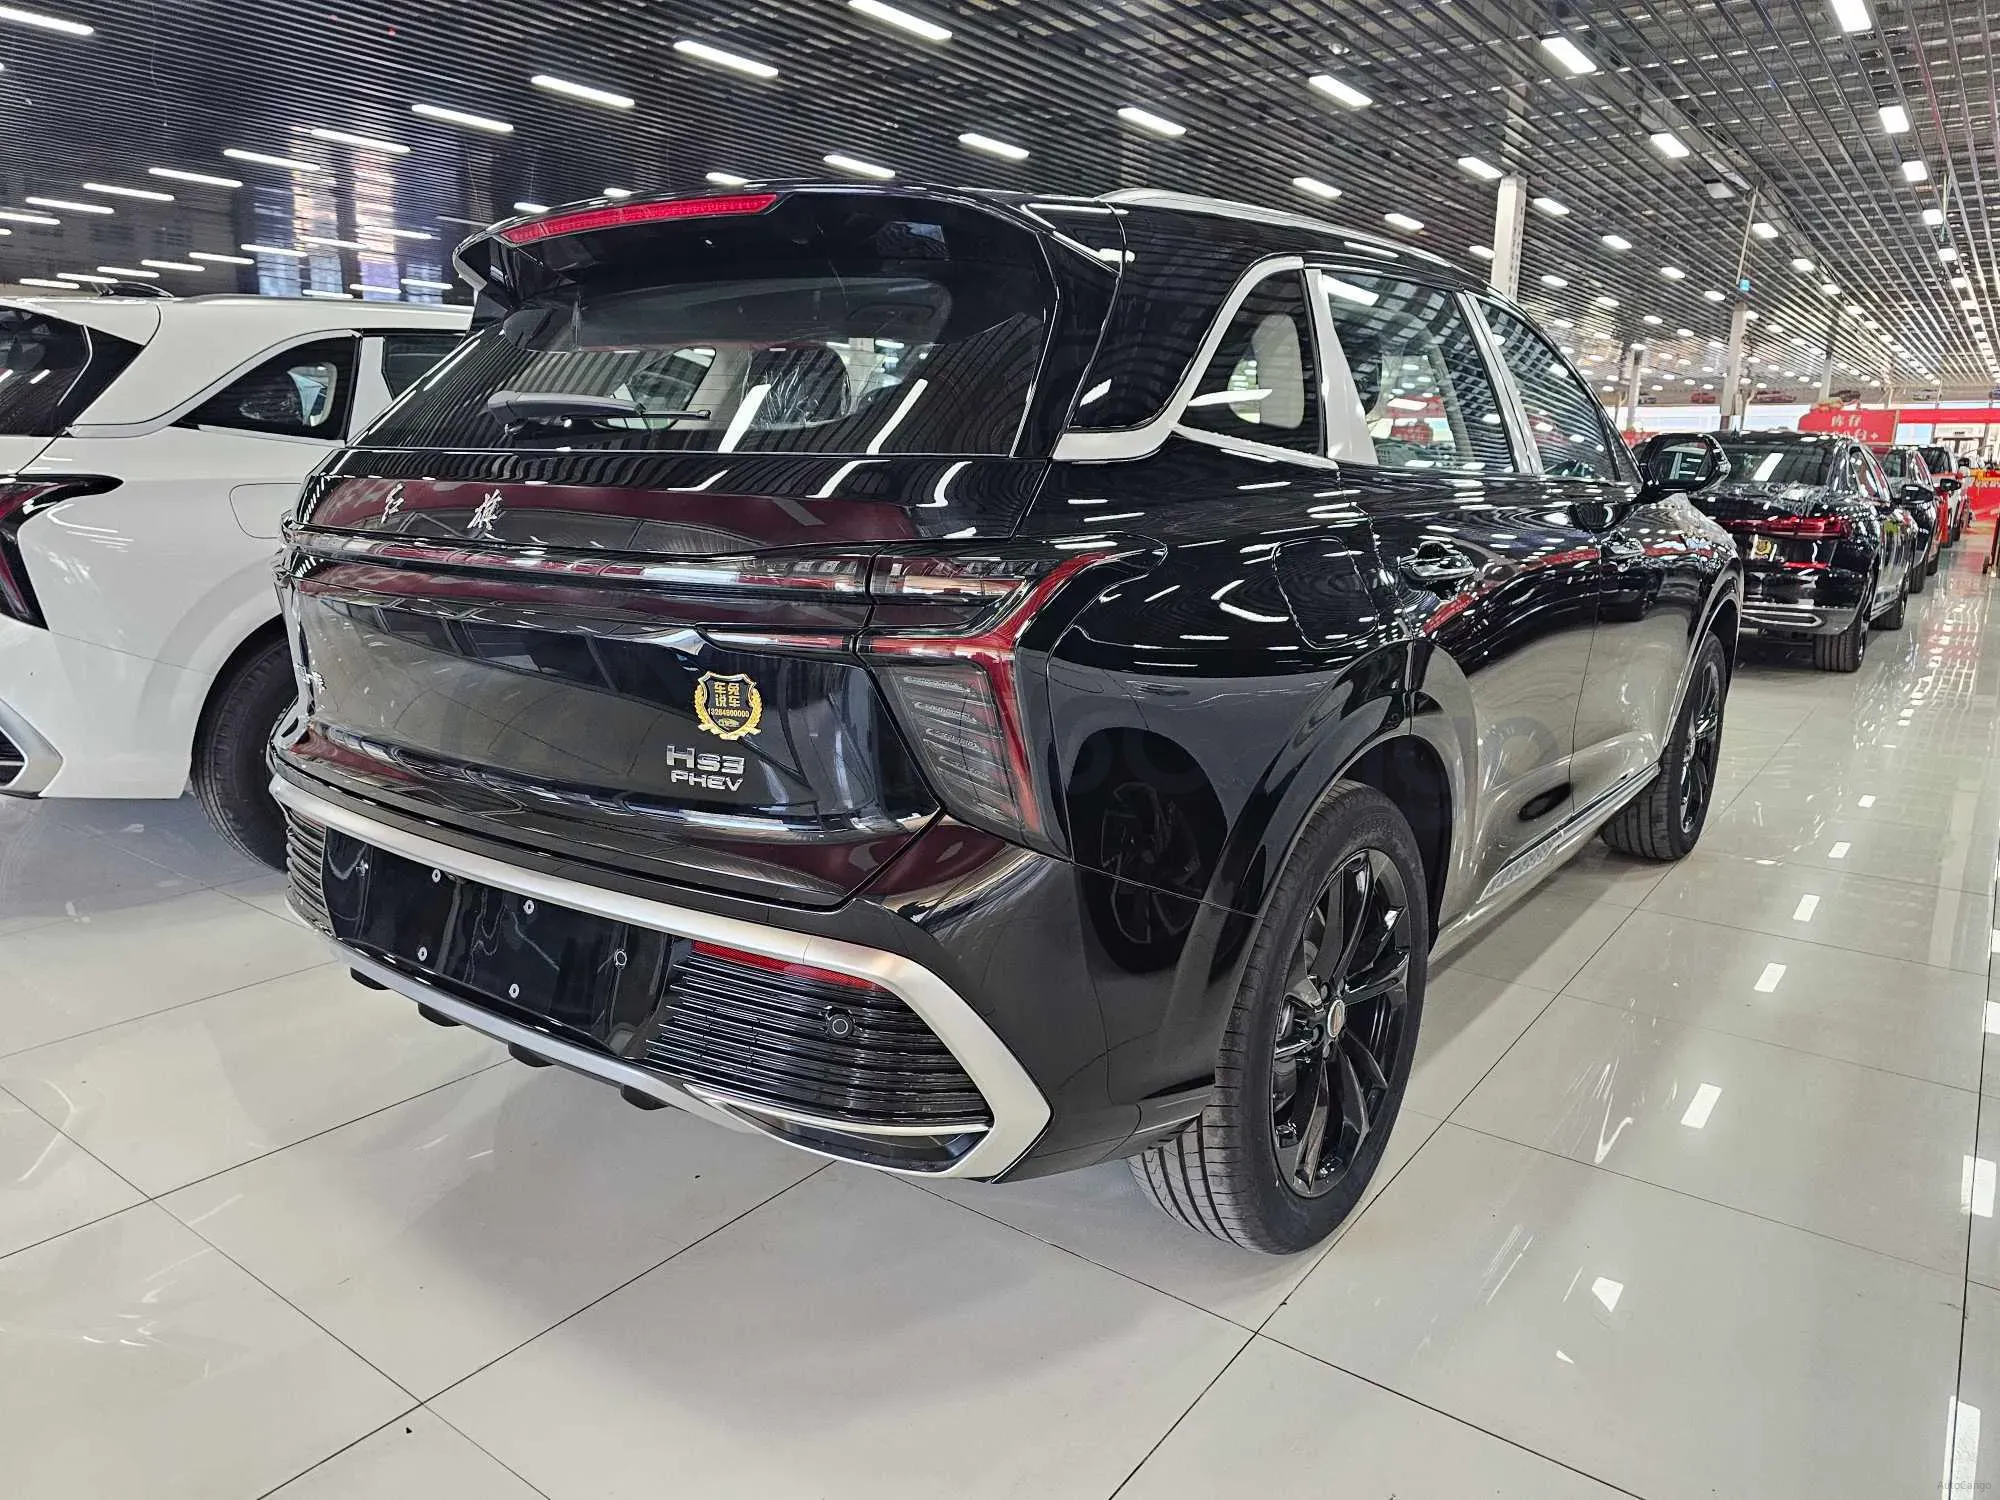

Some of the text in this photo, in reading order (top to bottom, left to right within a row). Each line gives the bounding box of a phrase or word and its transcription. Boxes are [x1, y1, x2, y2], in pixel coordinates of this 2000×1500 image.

[380, 482, 503, 531] 红旗
[666, 745, 745, 774] HS3
[671, 770, 744, 791] PHEV
